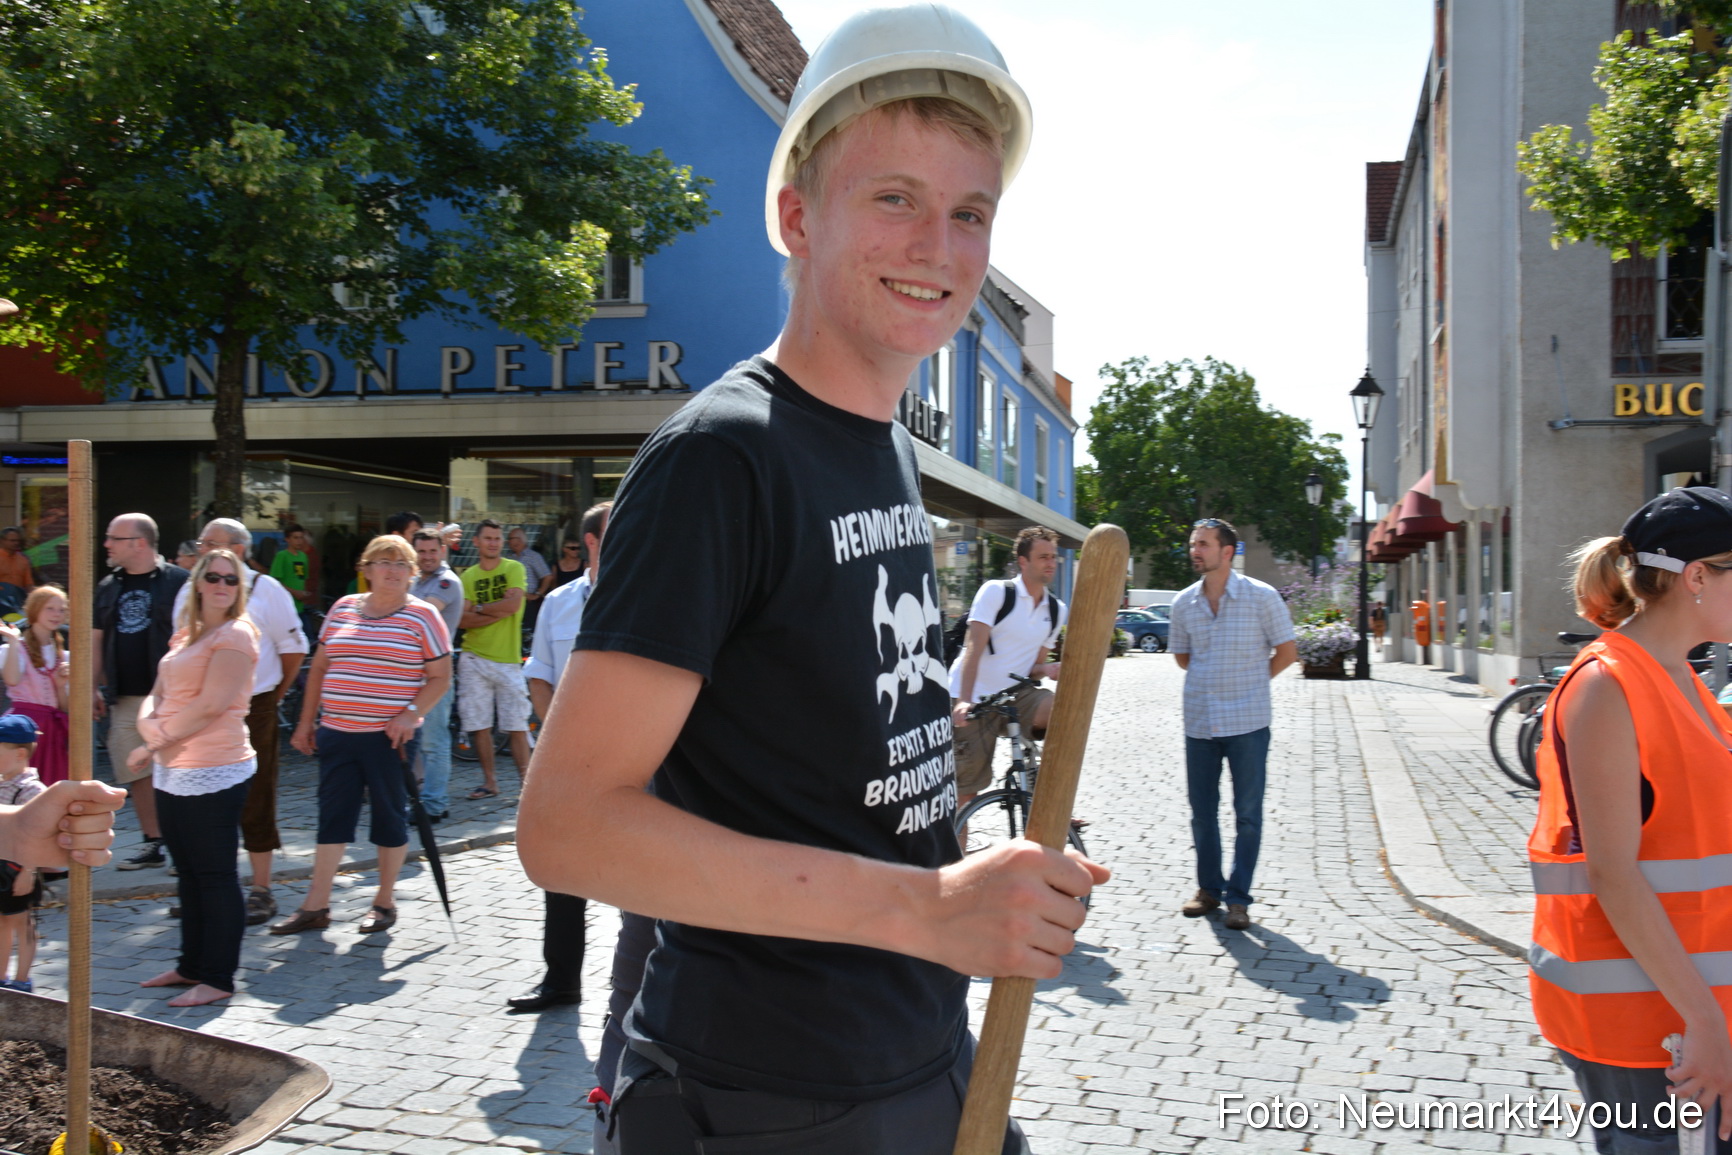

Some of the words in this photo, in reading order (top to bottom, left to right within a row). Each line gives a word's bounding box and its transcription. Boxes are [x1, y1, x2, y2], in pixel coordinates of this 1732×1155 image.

[441, 340, 687, 391] PETER
[830, 503, 932, 564] HEIMWERKE
[887, 727, 925, 767] ECHTE
[923, 715, 954, 749] KERL
